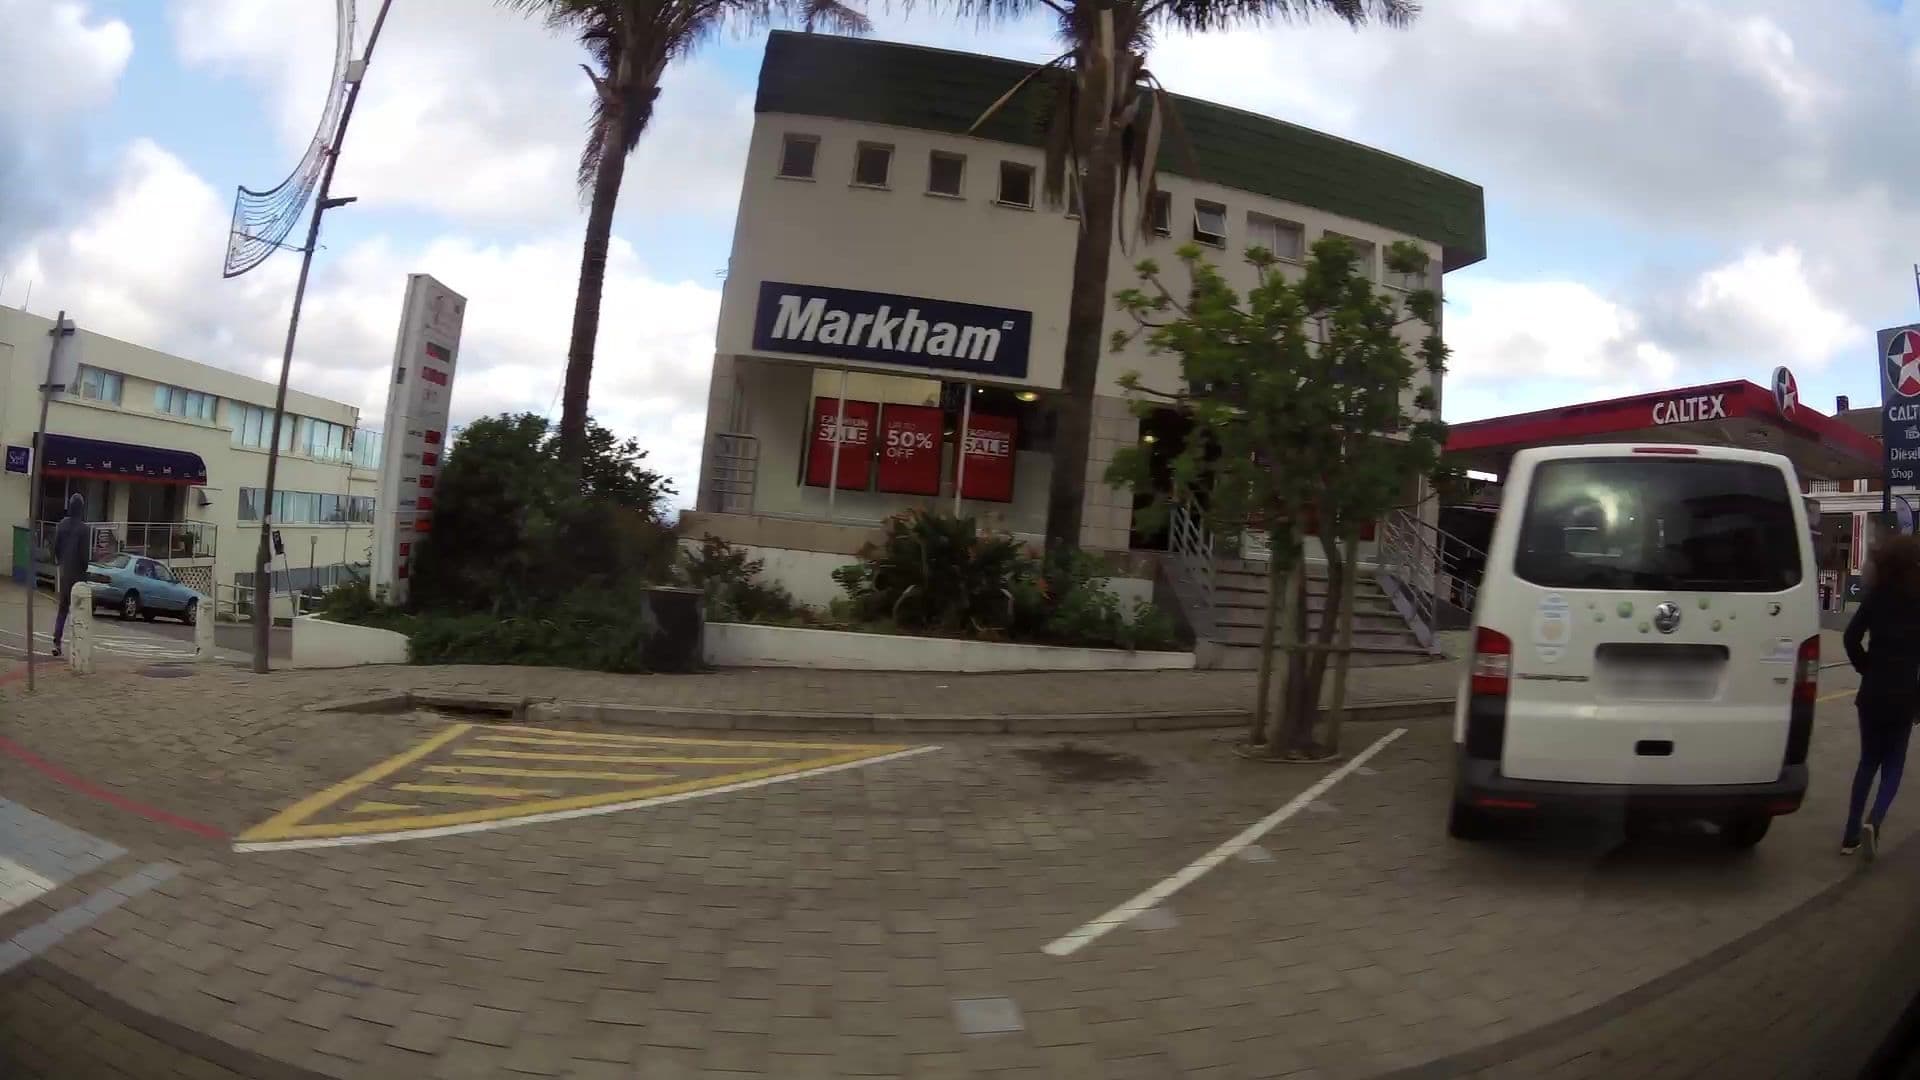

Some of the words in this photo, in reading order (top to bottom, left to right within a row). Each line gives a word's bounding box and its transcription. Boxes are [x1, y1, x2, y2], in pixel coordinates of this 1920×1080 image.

[771, 294, 1001, 362] Markham
[1652, 393, 1726, 425] CALTEX
[1888, 404, 1920, 422] CALT
[886, 429, 934, 449] 50%
[886, 447, 915, 459] OFF
[1891, 468, 1914, 480] Shop
